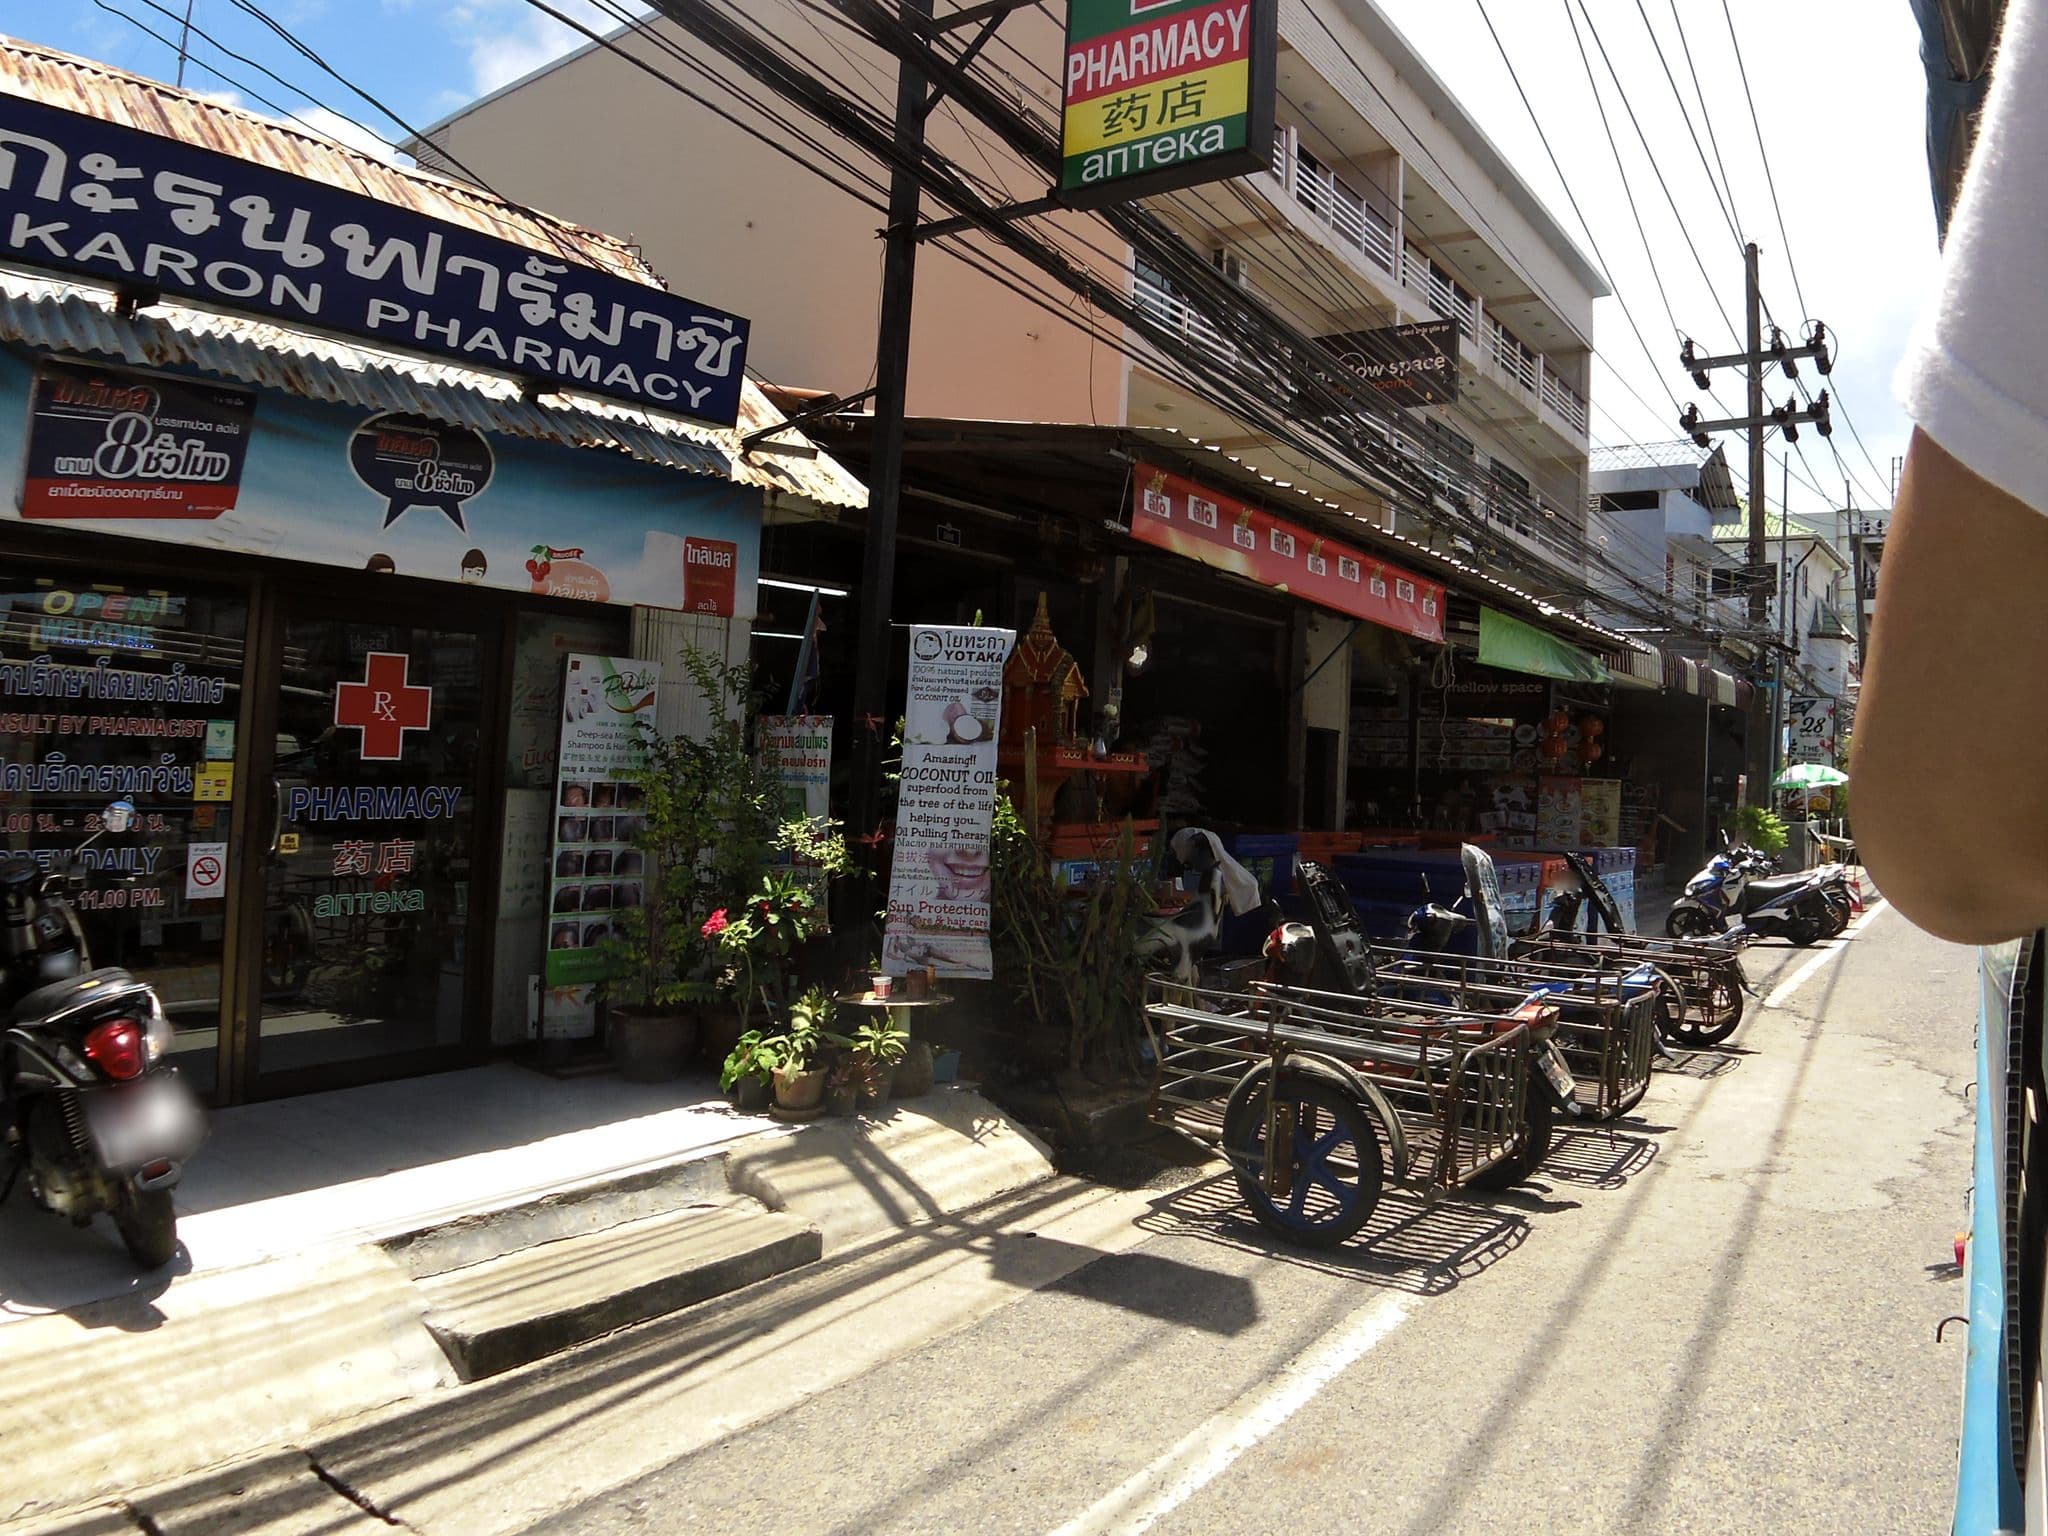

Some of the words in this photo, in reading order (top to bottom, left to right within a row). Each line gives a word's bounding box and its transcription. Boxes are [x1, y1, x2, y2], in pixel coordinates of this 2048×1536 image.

[1067, 4, 1248, 97] PHARMACY
[1101, 79, 1208, 139] 药店
[1081, 124, 1225, 183] аптека
[9, 213, 324, 316] KARON
[366, 297, 713, 410] PHARMACY
[1389, 355, 1446, 377] space
[54, 456, 94, 476] นาน
[94, 411, 154, 480] 8
[136, 433, 231, 482] ชั่วโมง
[414, 459, 439, 493] 8
[686, 543, 732, 569] ไทลินอล
[43, 590, 160, 621] OPEN
[945, 630, 1006, 651] โยทะกา
[943, 650, 1003, 663] YOTAKA
[937, 668, 968, 677] natural
[914, 693, 949, 702] COCONUT
[1447, 681, 1498, 694] mellow
[1502, 683, 1544, 696] space
[372, 691, 397, 721] Rx
[59, 714, 88, 735] BY
[89, 716, 208, 738] PHARMACIST
[577, 729, 614, 740] Deep-sea
[1799, 716, 1827, 734] 28
[567, 740, 604, 752] Shampoo
[922, 752, 977, 767] Amazing!!
[901, 766, 970, 783] COCONUT
[973, 771, 995, 785] OIL
[907, 783, 961, 796] superfood
[962, 785, 989, 796] from
[287, 785, 463, 822] PHARMACY
[900, 797, 915, 807] the
[918, 799, 940, 808] tree
[943, 799, 955, 809] of
[958, 800, 975, 811] the
[978, 801, 993, 812] life
[909, 812, 950, 827] helping
[896, 826, 908, 837] Oil
[911, 827, 948, 841] Pulling
[897, 838, 927, 849] Масло
[80, 846, 163, 876] DAILY
[331, 838, 416, 876] 药店
[78, 889, 125, 910] 11.00
[313, 888, 425, 918] аптека
[889, 899, 914, 913] Sun
[918, 901, 989, 917] Protection
[887, 914, 908, 924] Skin
[946, 916, 967, 927] hair
[968, 919, 988, 928] care
